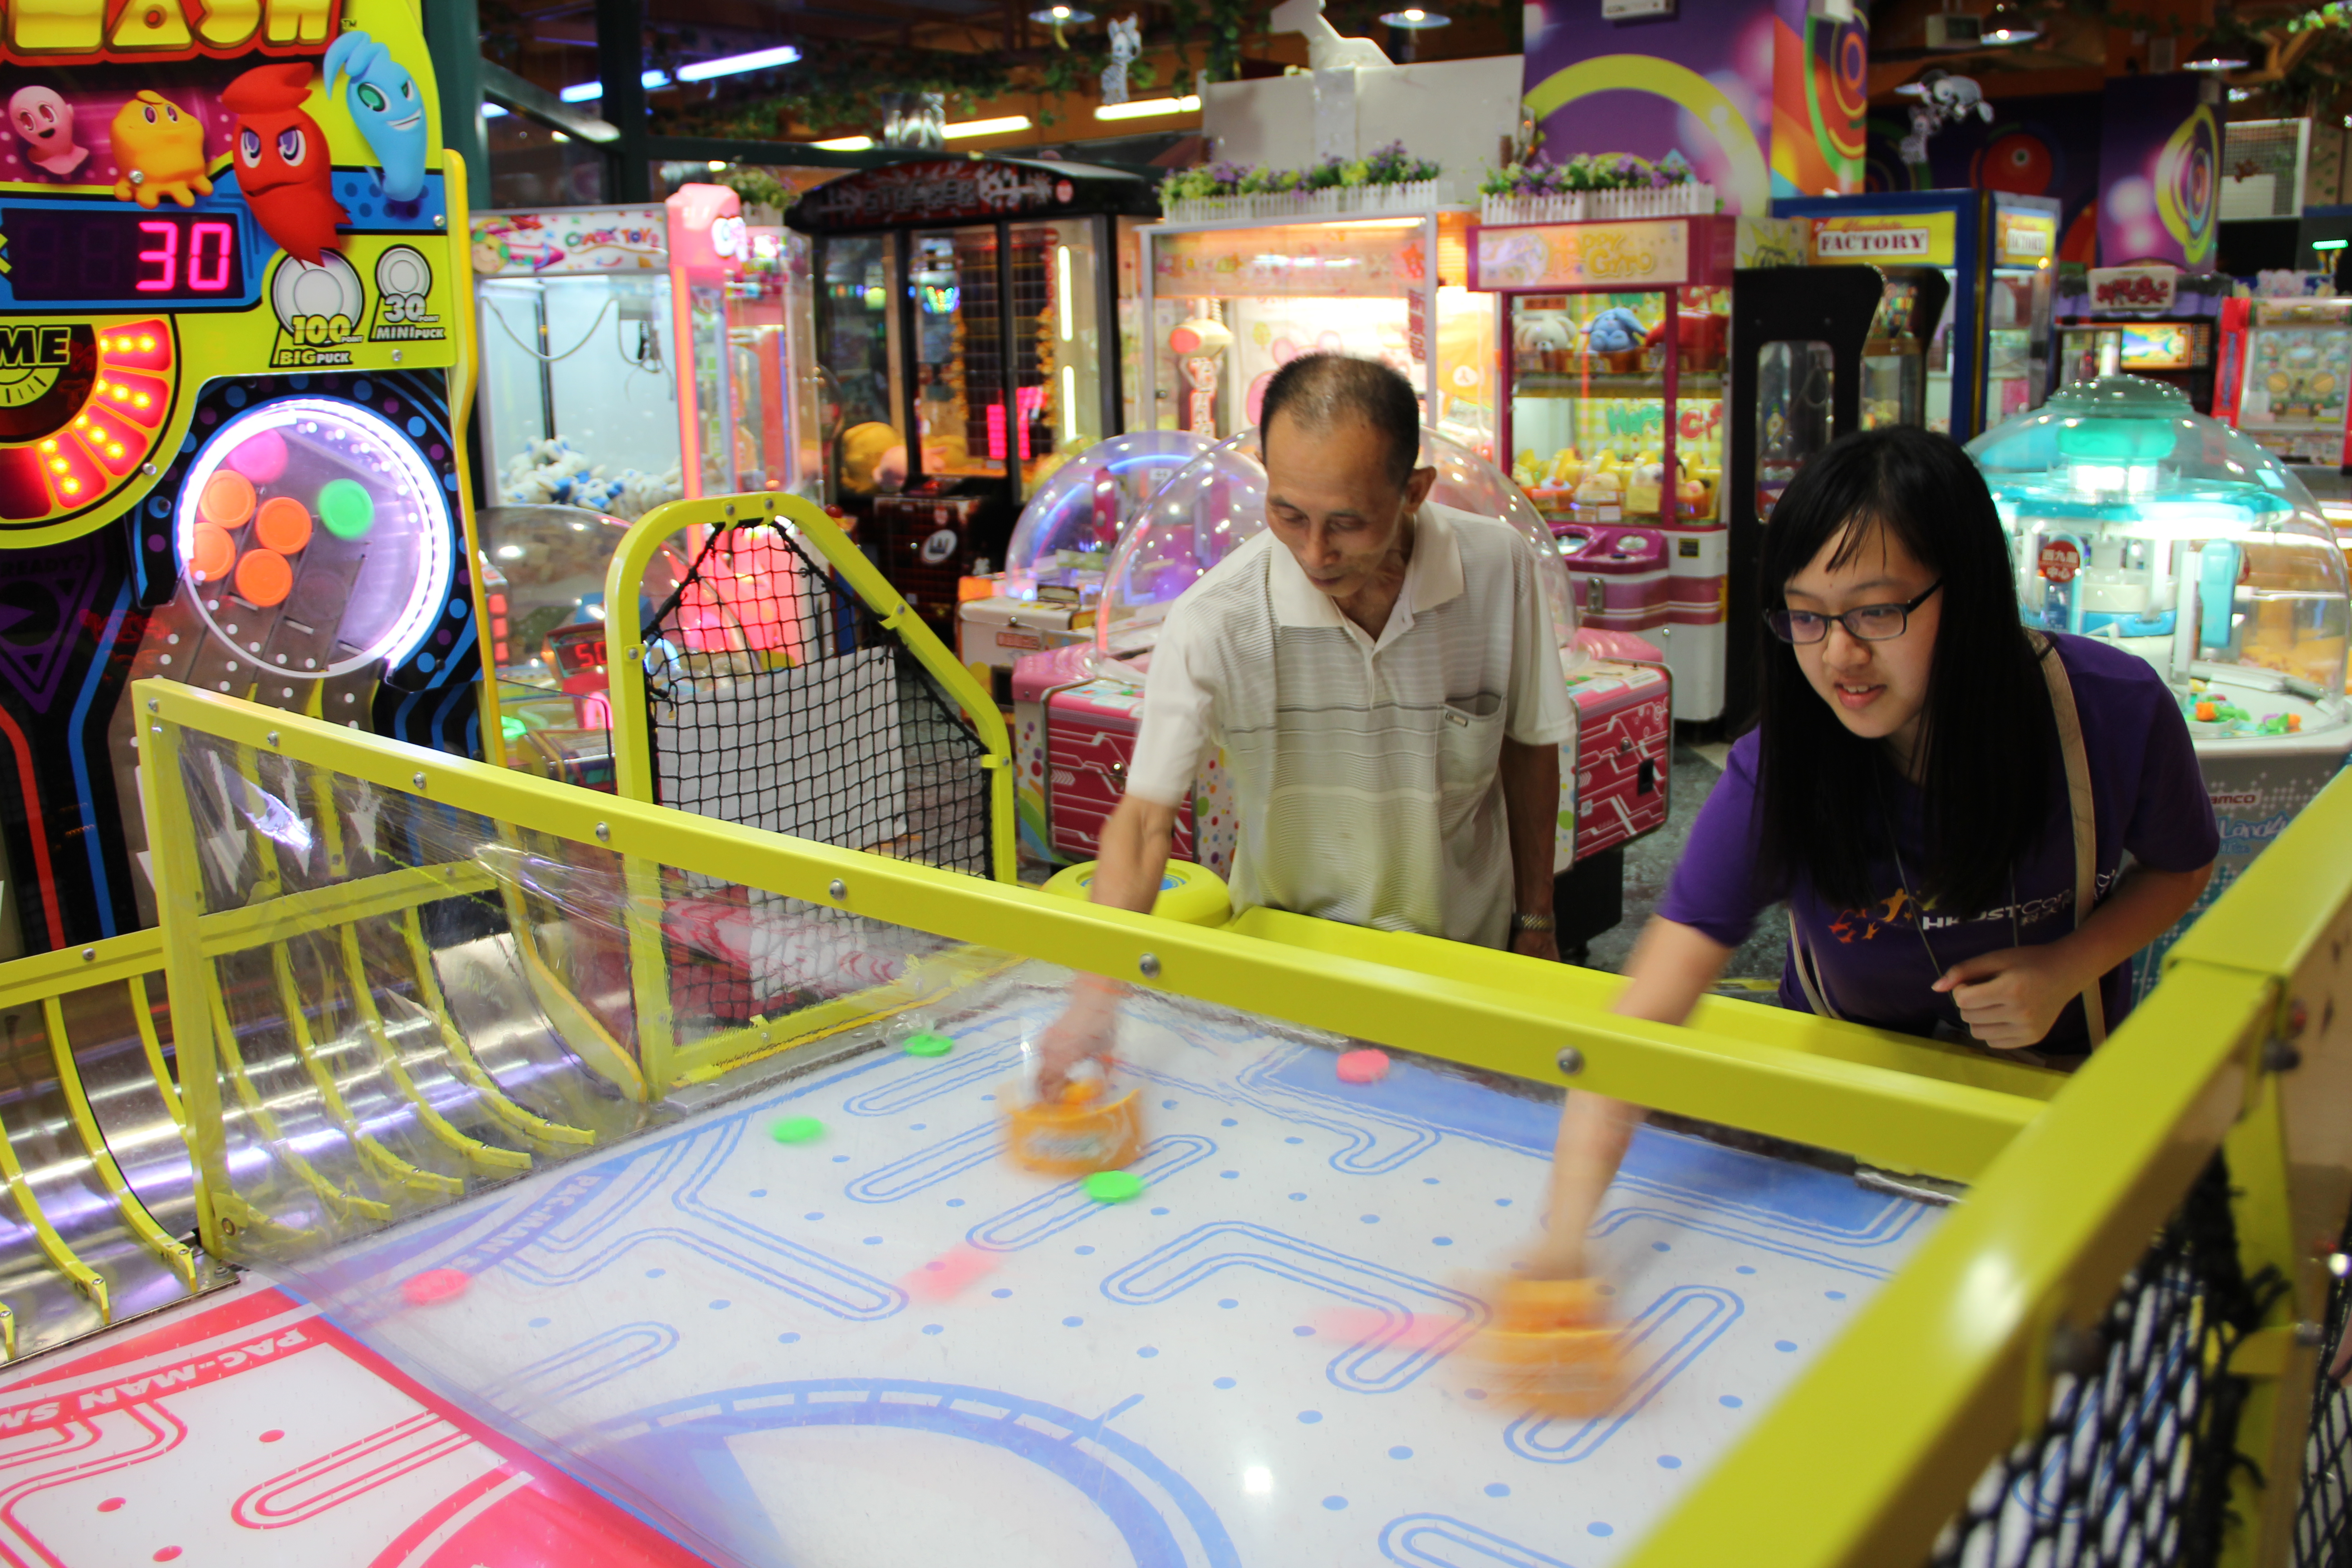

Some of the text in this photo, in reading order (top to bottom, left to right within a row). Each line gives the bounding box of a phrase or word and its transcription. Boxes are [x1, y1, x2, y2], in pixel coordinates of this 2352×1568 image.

[621, 227, 652, 244] TOY
[1821, 233, 1925, 251] FACTORY
[136, 221, 232, 291] 30
[384, 294, 440, 323] 30 POINT
[292, 313, 363, 347] 100 POINT
[2210, 794, 2256, 804] amco
[77, 1327, 308, 1411] PAC-MAN
